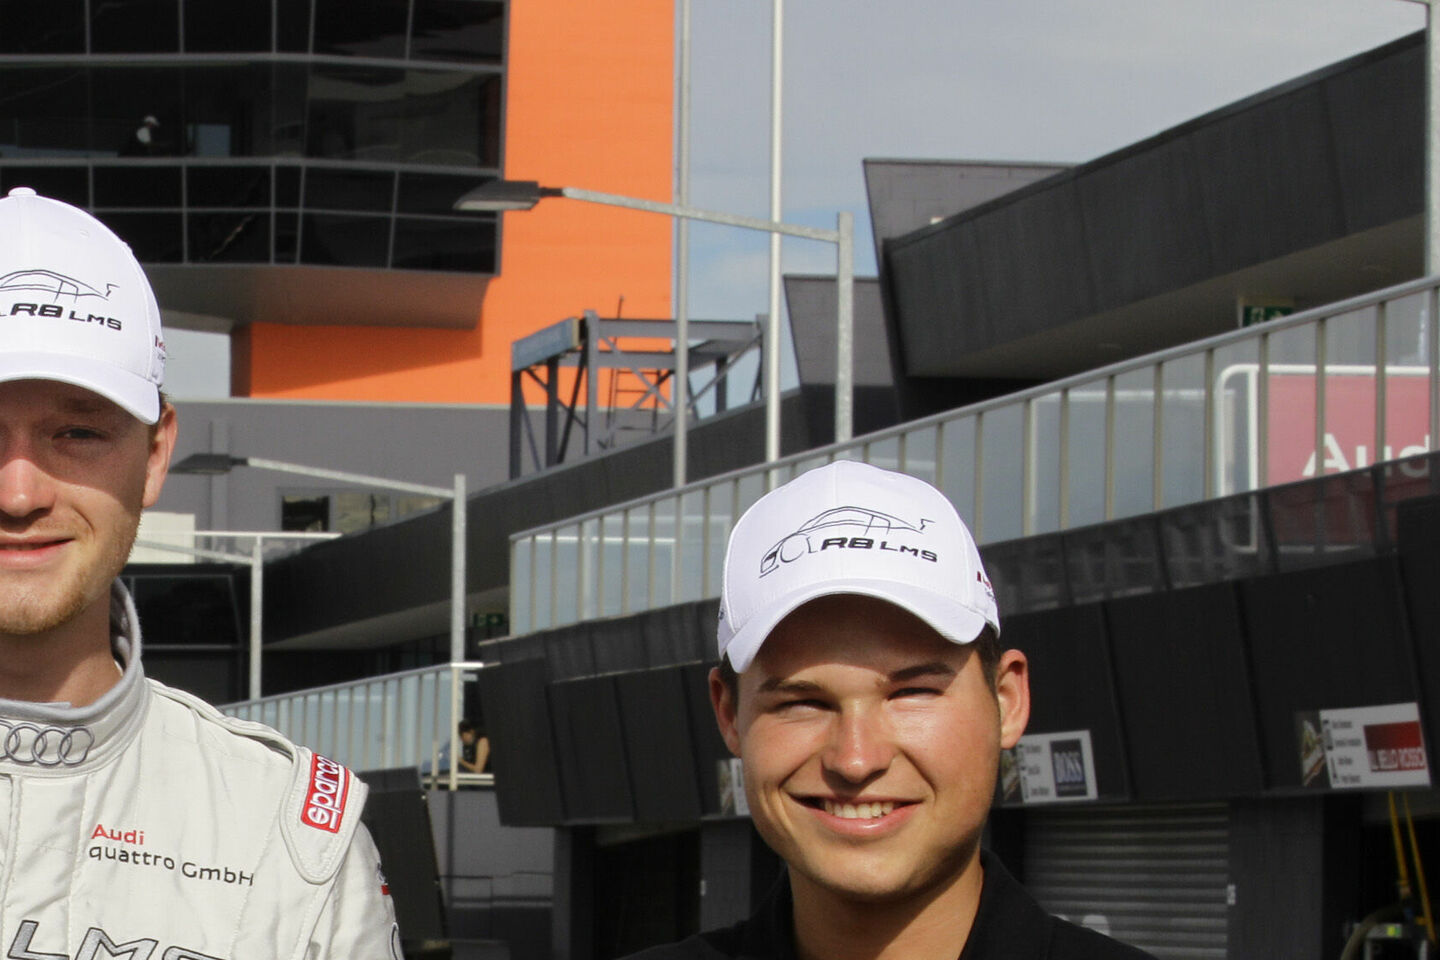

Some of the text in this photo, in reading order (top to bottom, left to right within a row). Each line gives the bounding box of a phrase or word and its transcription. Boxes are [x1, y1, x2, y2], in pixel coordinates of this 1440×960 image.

[10, 302, 123, 332] R8 LMS
[1302, 433, 1430, 478] Aud
[820, 536, 938, 564] R8 LMS
[91, 824, 143, 845] Audi
[89, 847, 253, 886] quattro GmbH
